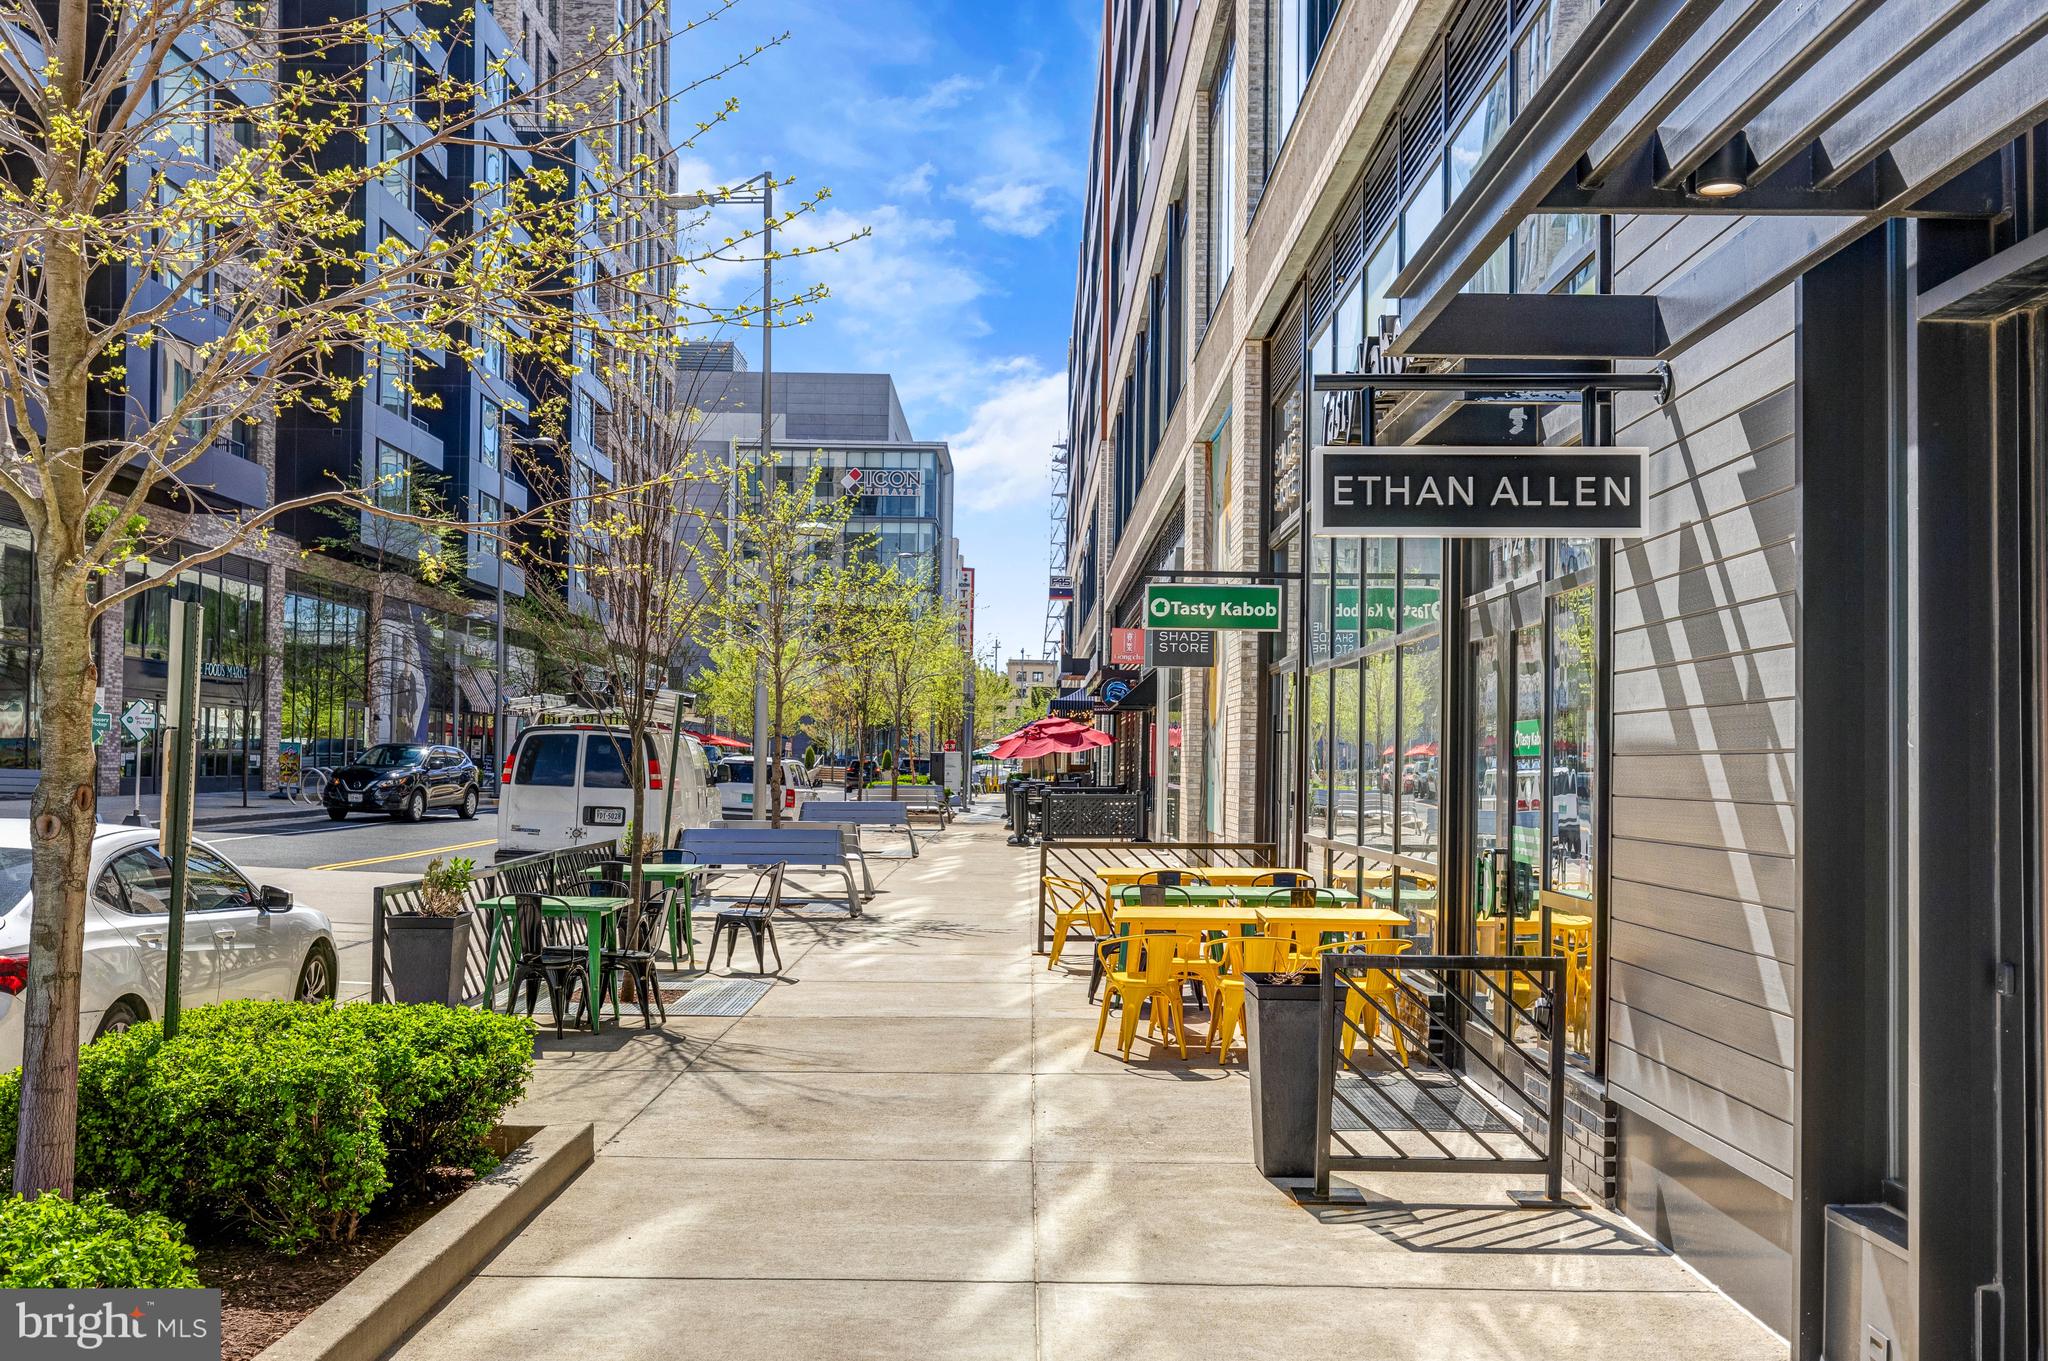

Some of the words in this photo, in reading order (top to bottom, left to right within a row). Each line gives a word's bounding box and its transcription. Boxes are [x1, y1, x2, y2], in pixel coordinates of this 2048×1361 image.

[866, 470, 921, 487] ICON
[866, 487, 921, 496] THEATRE
[1333, 475, 1475, 507] ETHAN
[1490, 475, 1632, 507] ALLEN
[1051, 577, 1071, 587] F45
[1171, 601, 1216, 619] Tasty
[1221, 601, 1277, 617] Kabob
[1159, 631, 1209, 642] SHADE
[1159, 643, 1209, 653] STORE
[204, 662, 225, 677] FOODS
[226, 664, 247, 679] MARKE
